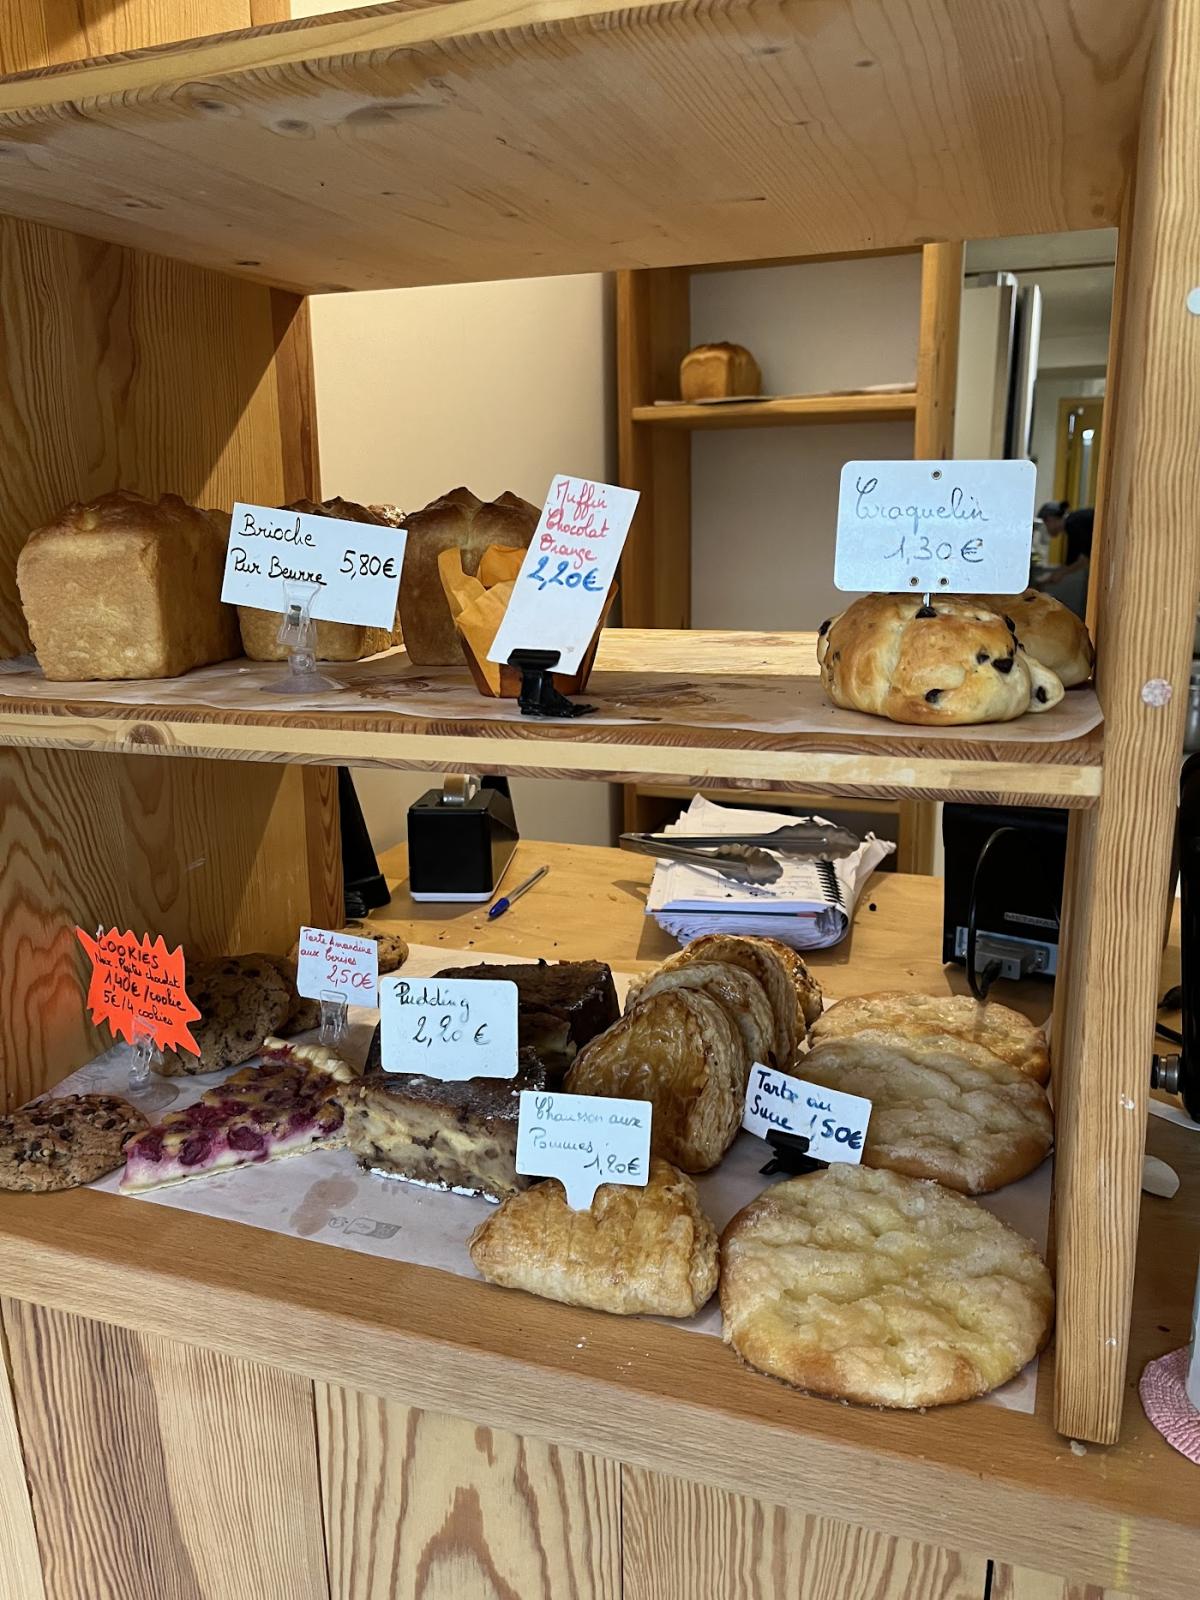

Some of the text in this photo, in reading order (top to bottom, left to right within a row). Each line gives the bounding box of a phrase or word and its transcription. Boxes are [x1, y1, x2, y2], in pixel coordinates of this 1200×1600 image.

[556, 479, 608, 521] Muffin
[855, 476, 989, 536] Craquelin
[238, 512, 317, 547] Brioche
[546, 507, 610, 539] Chocolat
[230, 546, 328, 586] Pur Beurre
[339, 549, 398, 580] 5,80€
[539, 532, 598, 570] Orange
[526, 555, 604, 593] 2,20€
[98, 936, 159, 969] COOKIES
[300, 948, 320, 957] aux
[303, 928, 327, 945] Tarte
[326, 964, 375, 990] 2,50€
[392, 981, 470, 1024] Pudding
[534, 1096, 644, 1129] Chausson aux
[806, 1096, 833, 1112] au
[528, 1126, 594, 1154] Pommes
